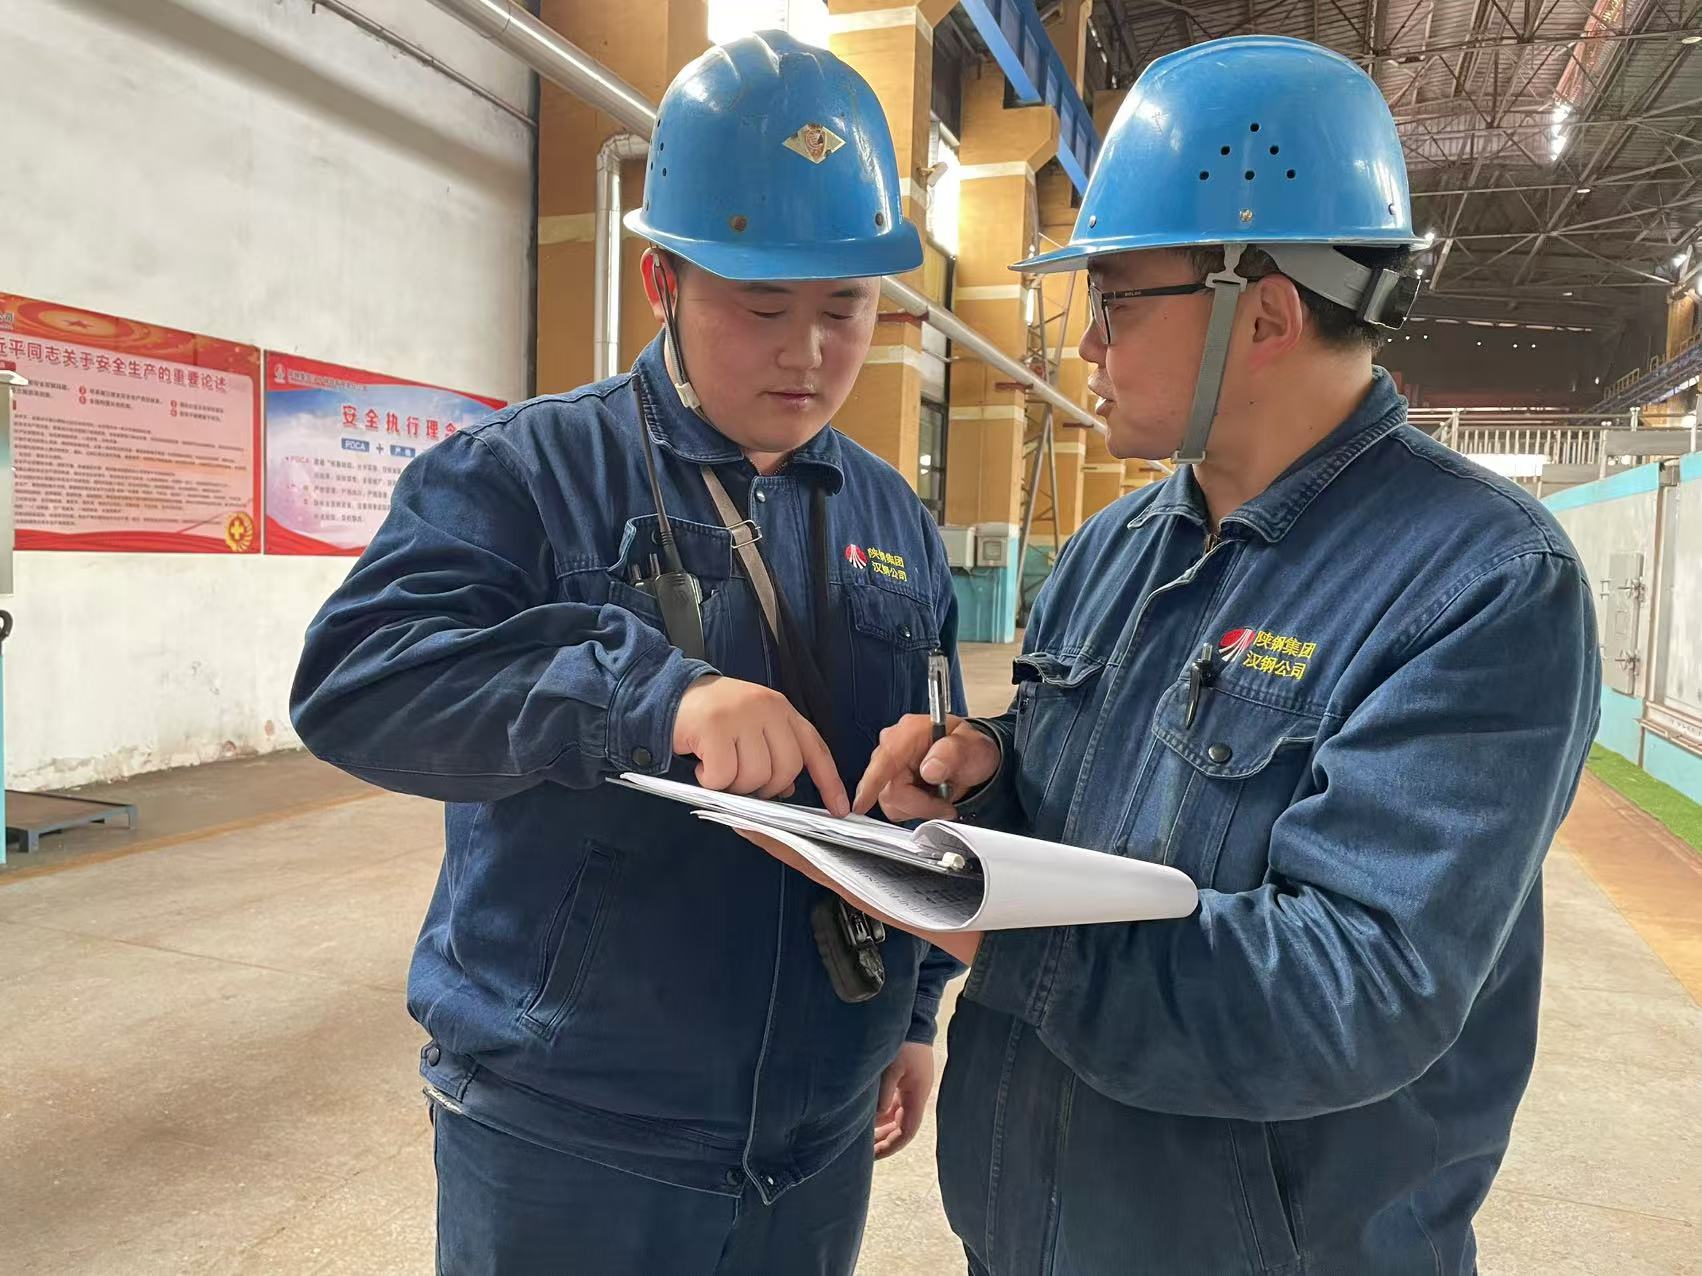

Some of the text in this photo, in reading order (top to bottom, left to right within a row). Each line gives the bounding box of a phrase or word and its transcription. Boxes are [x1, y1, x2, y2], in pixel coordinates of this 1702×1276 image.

[345, 440, 366, 450] PDCA
[868, 547, 904, 568] 陕钢集团
[872, 560, 907, 581] 汉钢公司
[1253, 631, 1316, 659] 陕钢集团
[1243, 650, 1306, 679] 汉钢公司
